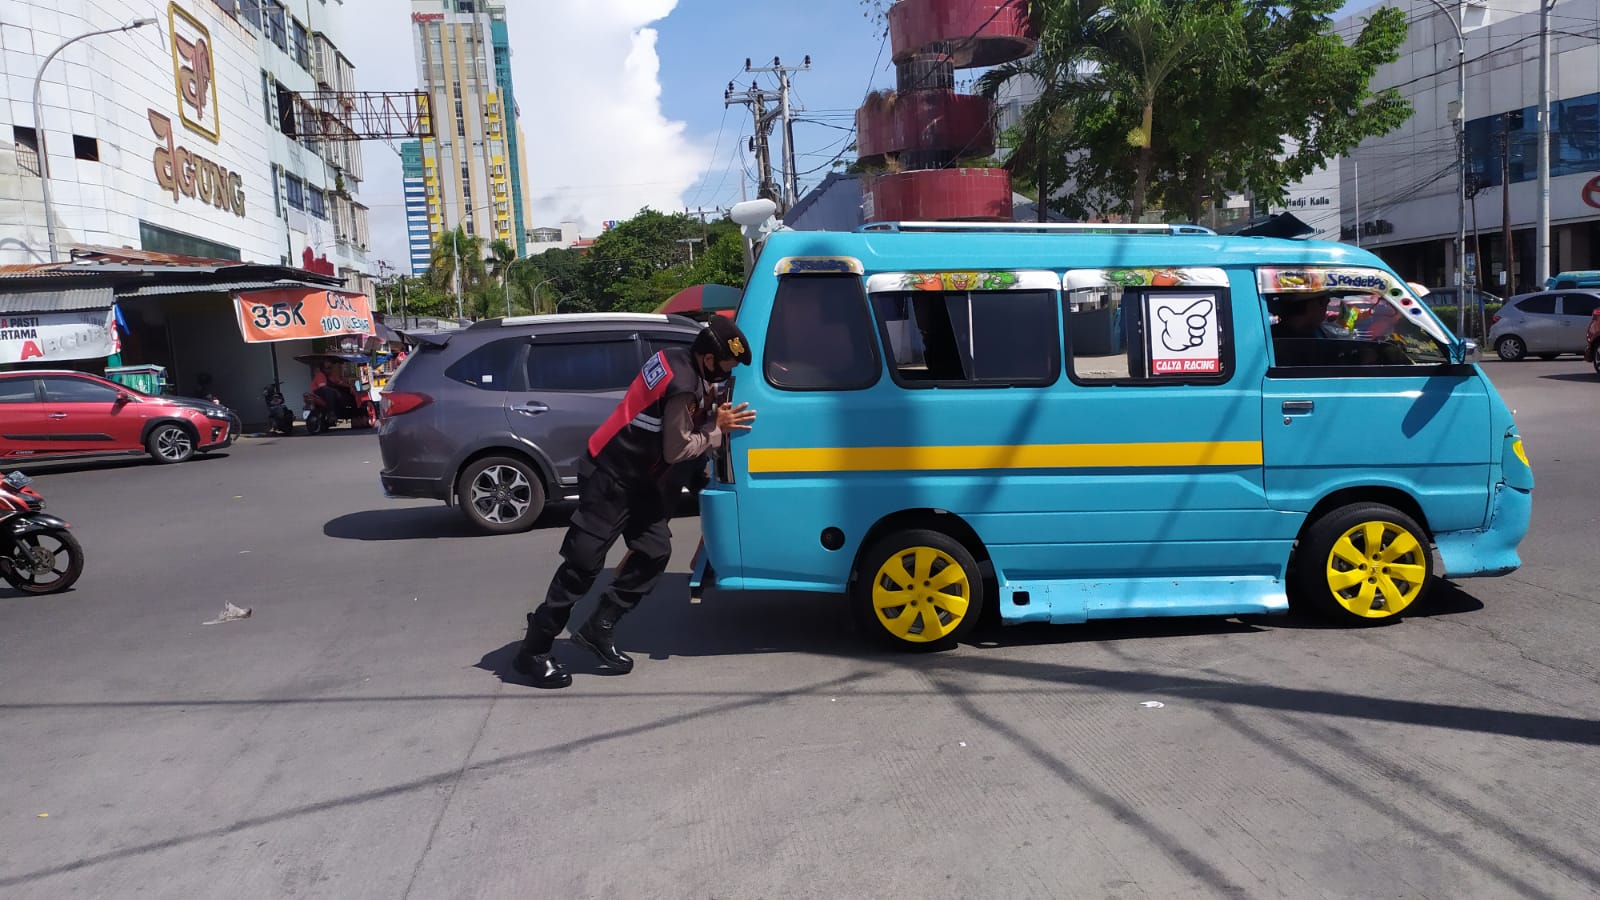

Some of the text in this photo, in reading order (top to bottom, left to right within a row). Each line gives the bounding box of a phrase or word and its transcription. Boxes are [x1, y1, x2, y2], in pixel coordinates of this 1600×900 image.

[1286, 195, 1330, 208] Hadji Kalla
[251, 301, 306, 329] 35K
[10, 317, 39, 328] PASTI
[321, 316, 341, 331] 100
[0, 329, 37, 340] RTAMA
[1156, 360, 1215, 370] CALYA RACING
